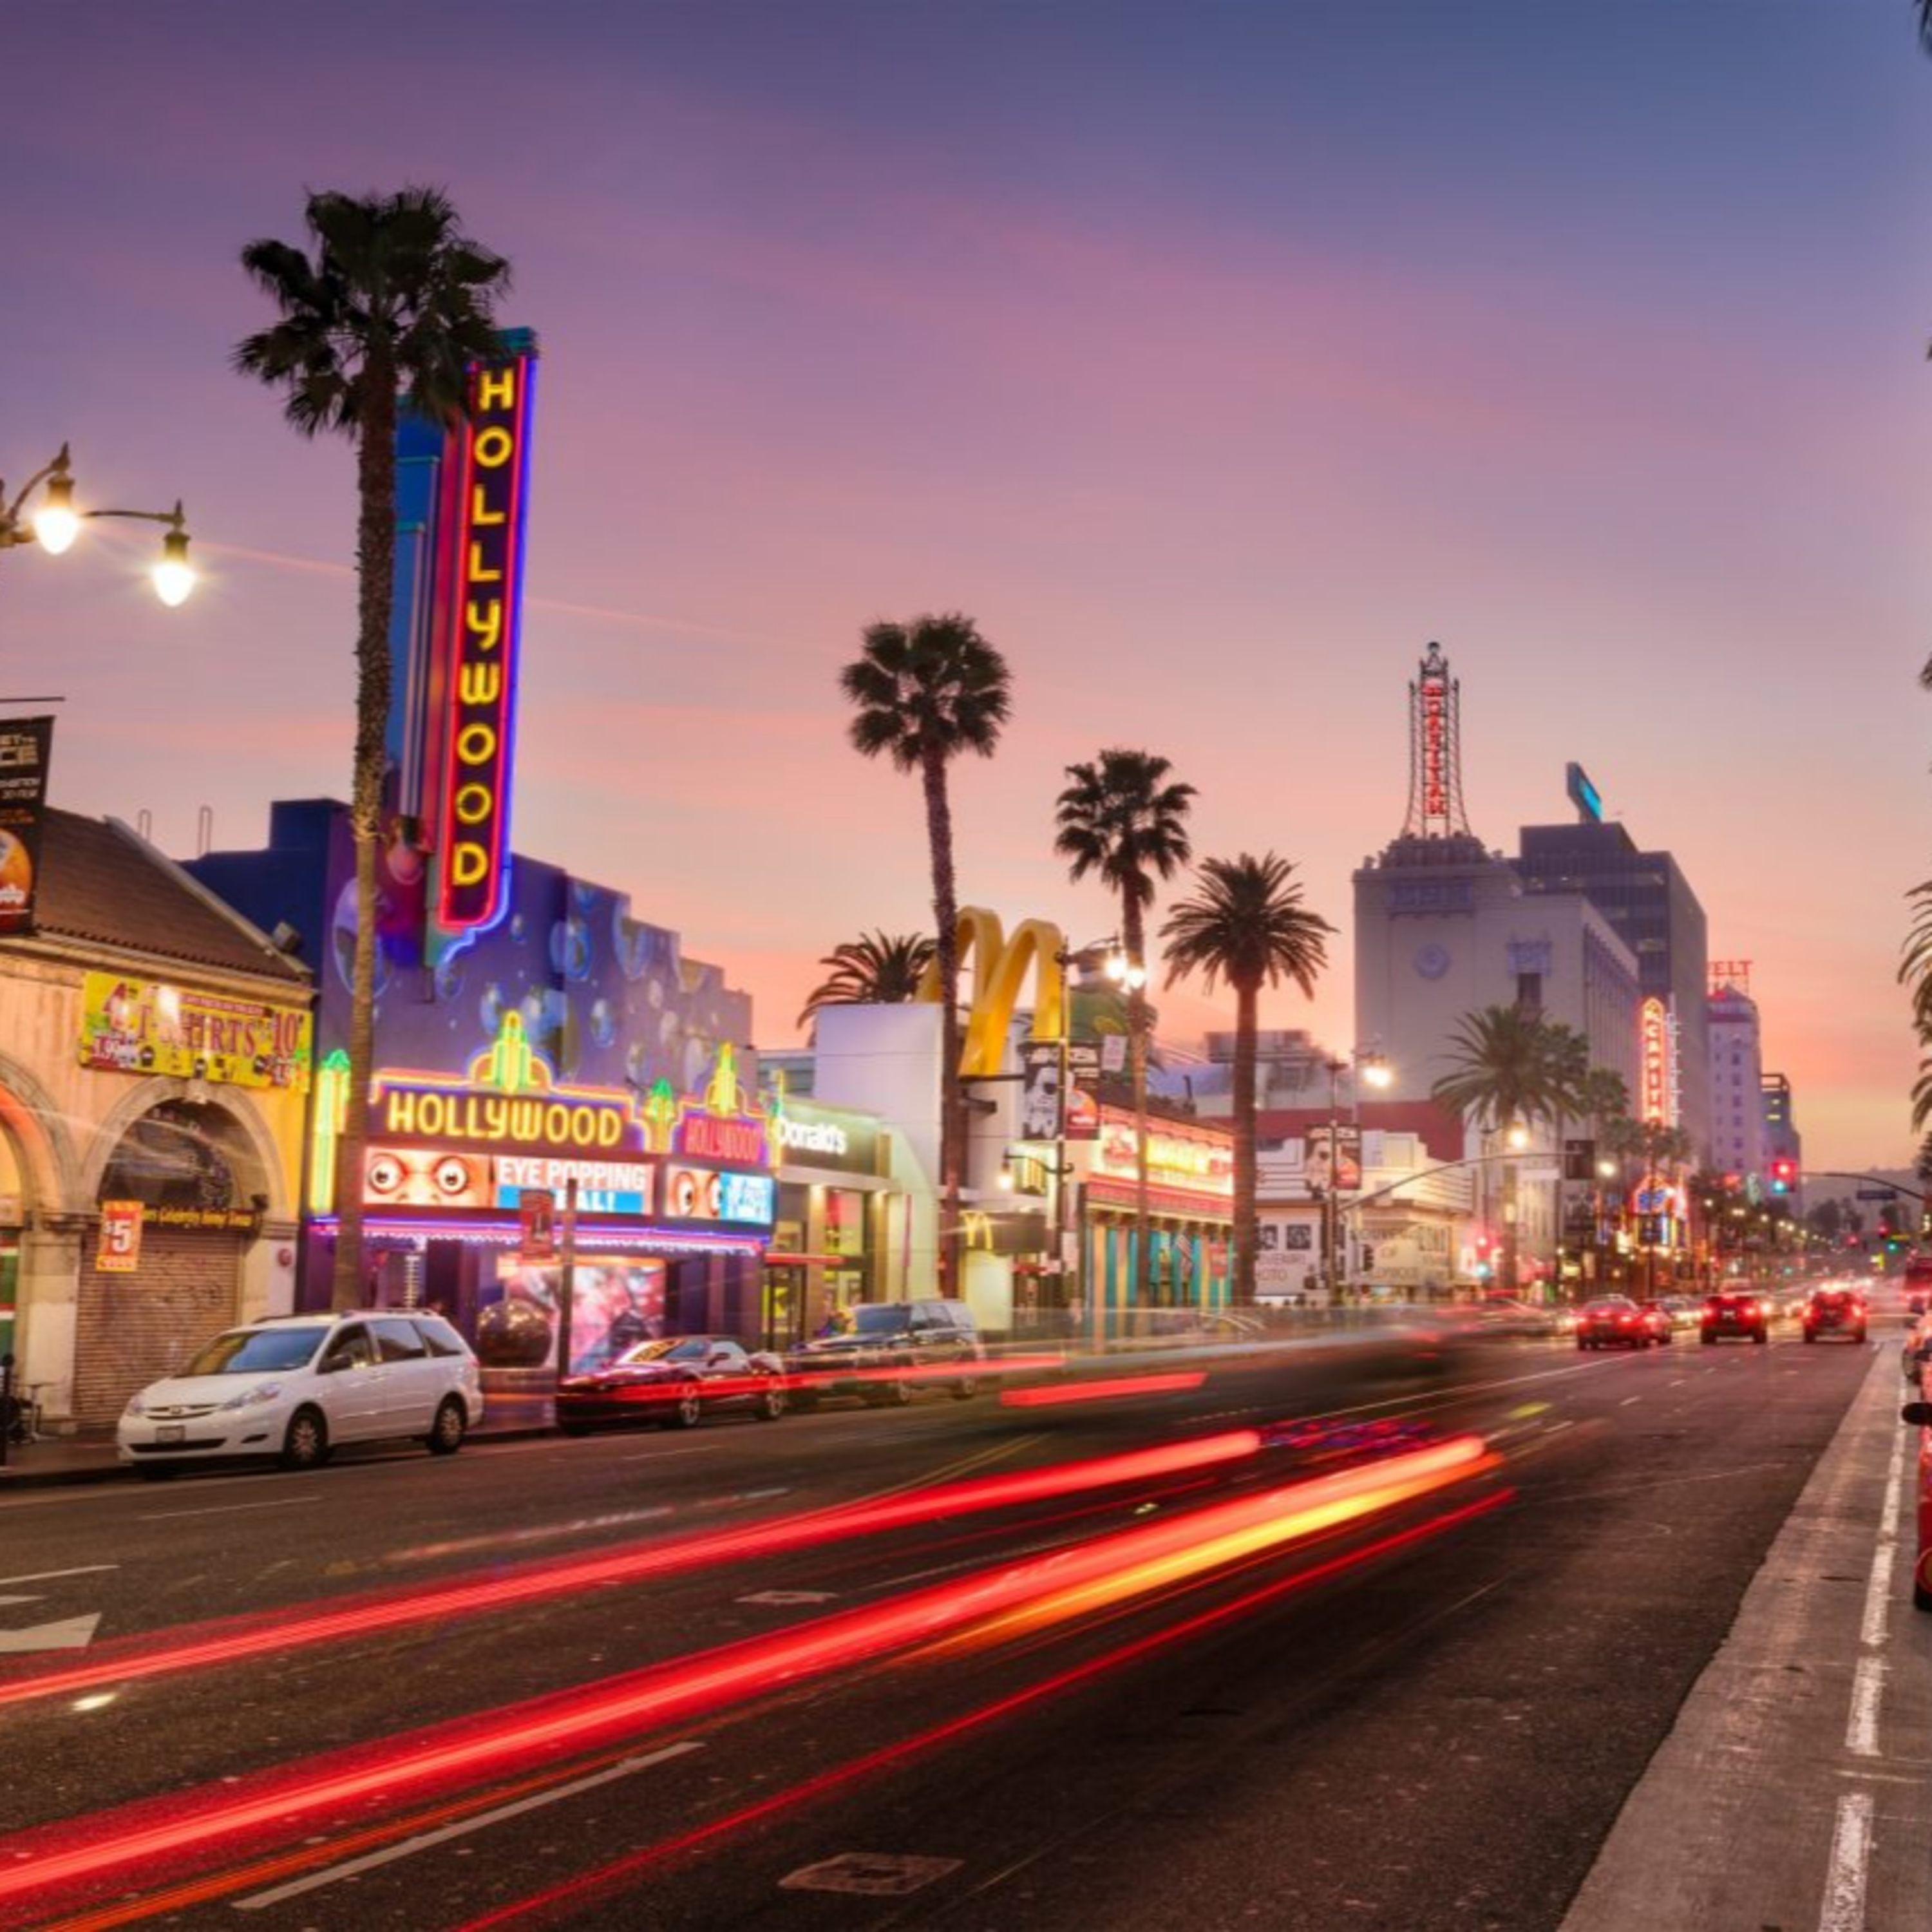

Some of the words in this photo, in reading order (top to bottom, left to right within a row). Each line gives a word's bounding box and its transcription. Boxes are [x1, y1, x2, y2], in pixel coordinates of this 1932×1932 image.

[453, 368, 513, 885] HOLLYWOOD
[388, 1090, 622, 1146] HOLLYWOOD
[498, 1157, 543, 1186] EYE
[547, 1159, 647, 1190] POPPING
